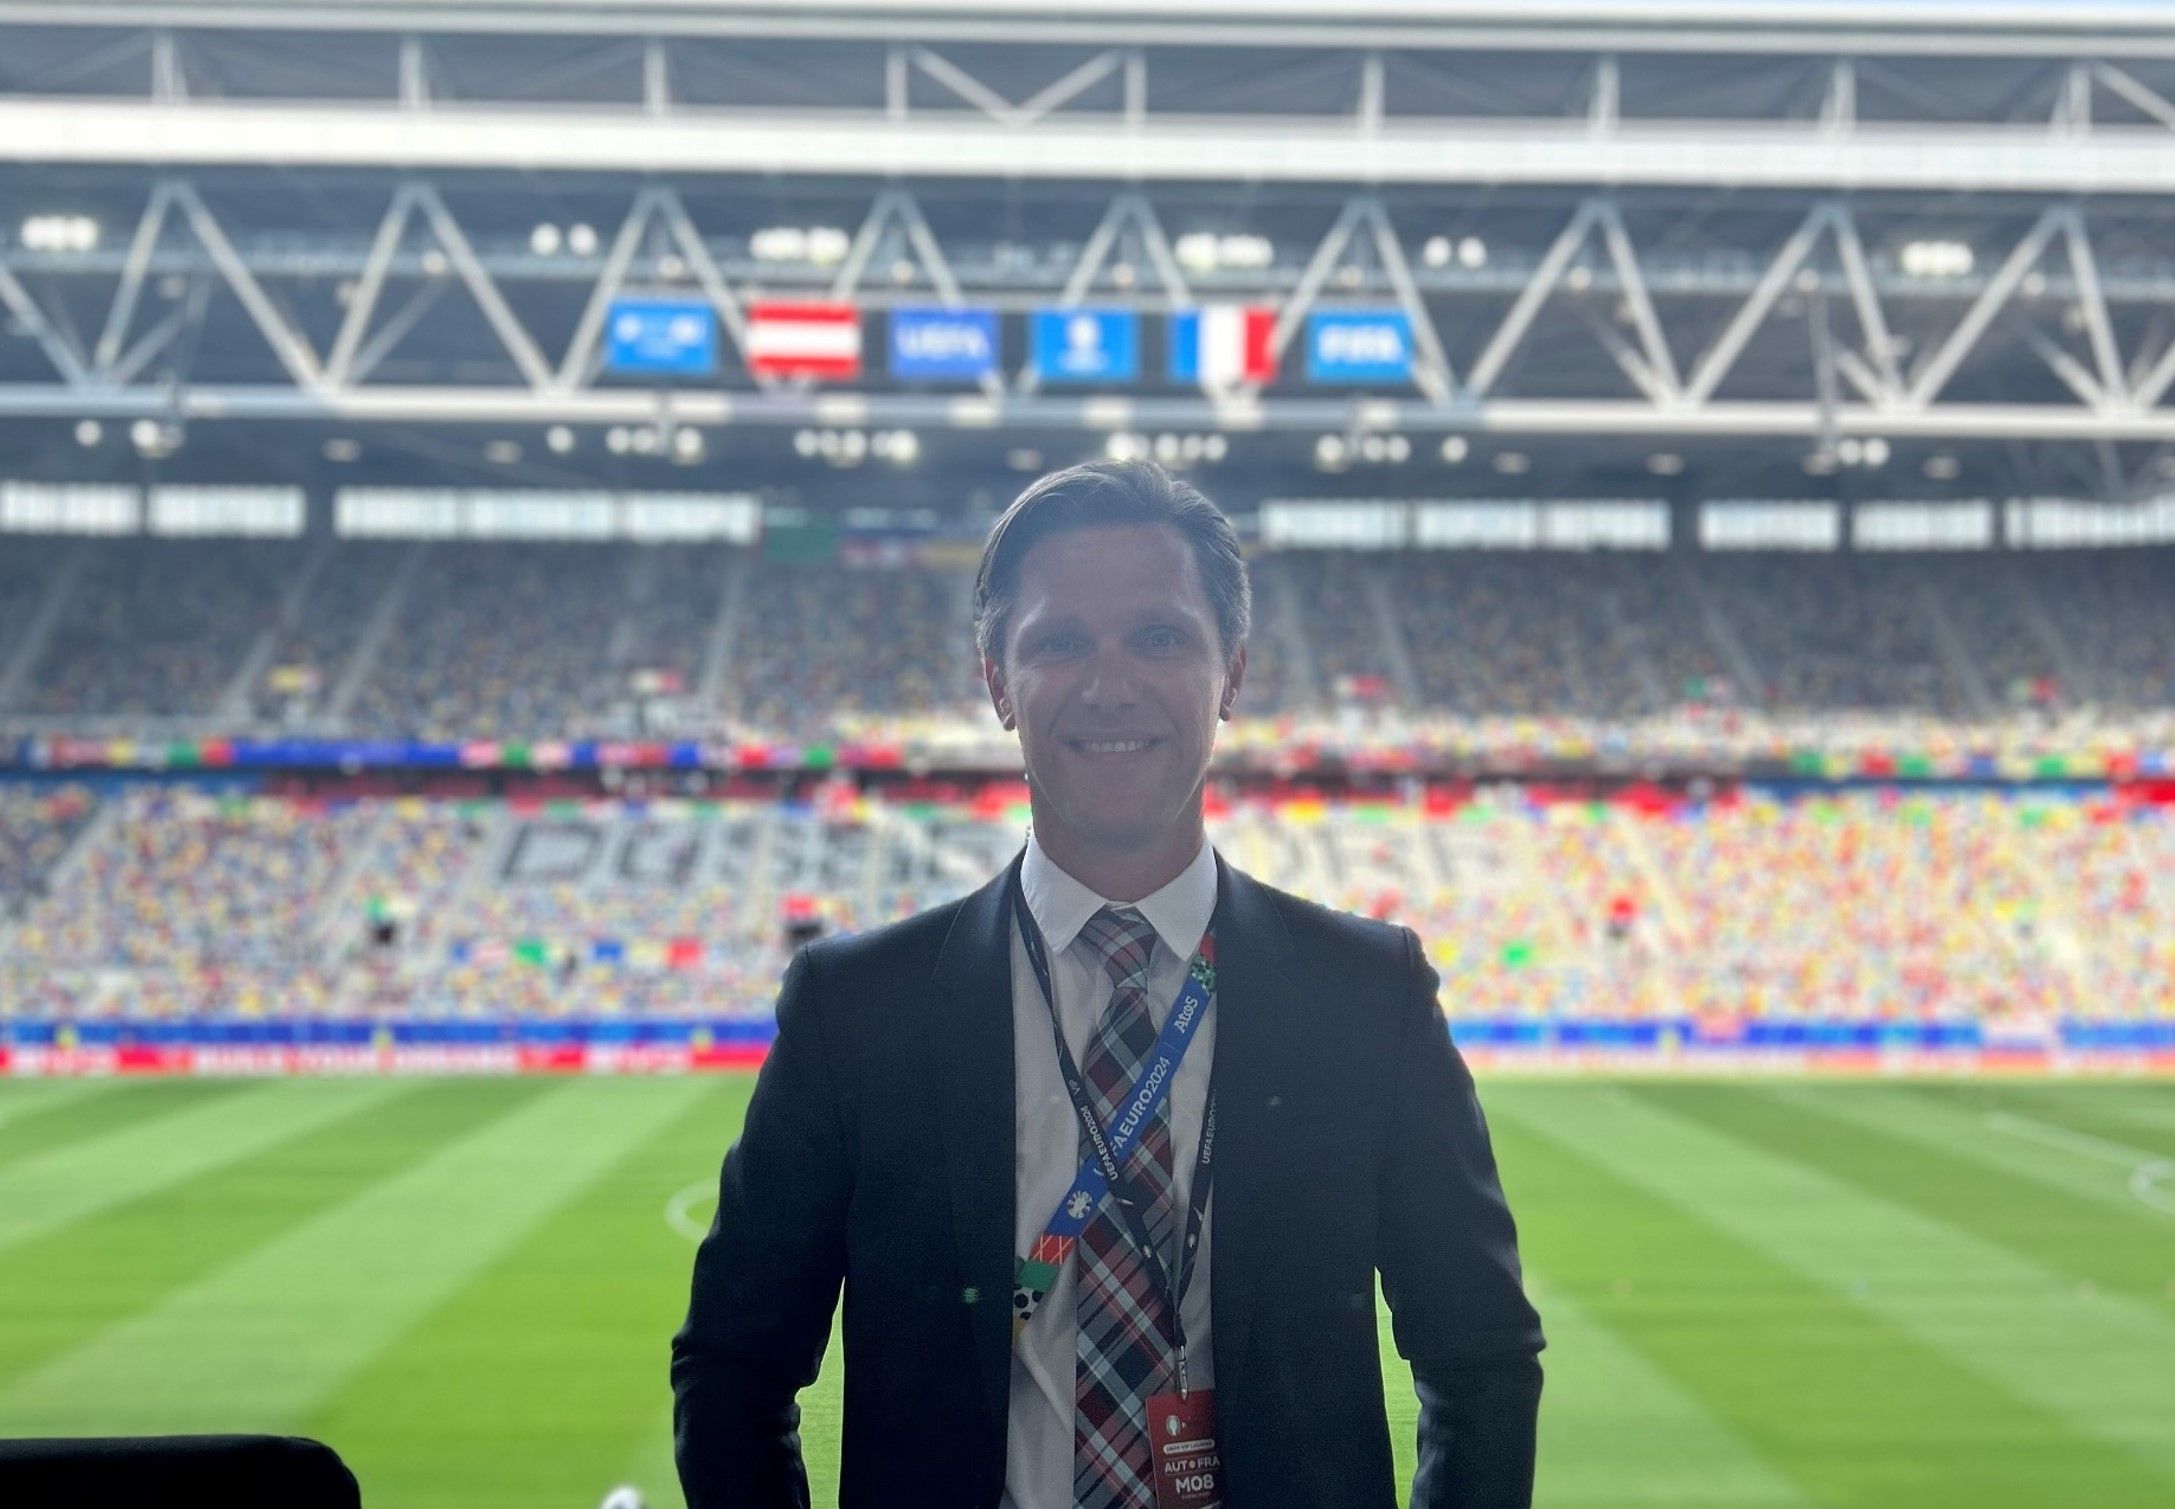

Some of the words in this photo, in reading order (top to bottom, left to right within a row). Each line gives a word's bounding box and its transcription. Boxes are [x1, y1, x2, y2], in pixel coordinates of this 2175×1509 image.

[896, 324, 990, 360] UEFA
[1319, 325, 1403, 363] FIFA
[1174, 996, 1198, 1034] Atos
[1081, 1105, 1118, 1180] UEFAEURO2024
[1165, 1460, 1188, 1473] AUT
[1197, 1456, 1220, 1468] FRA
